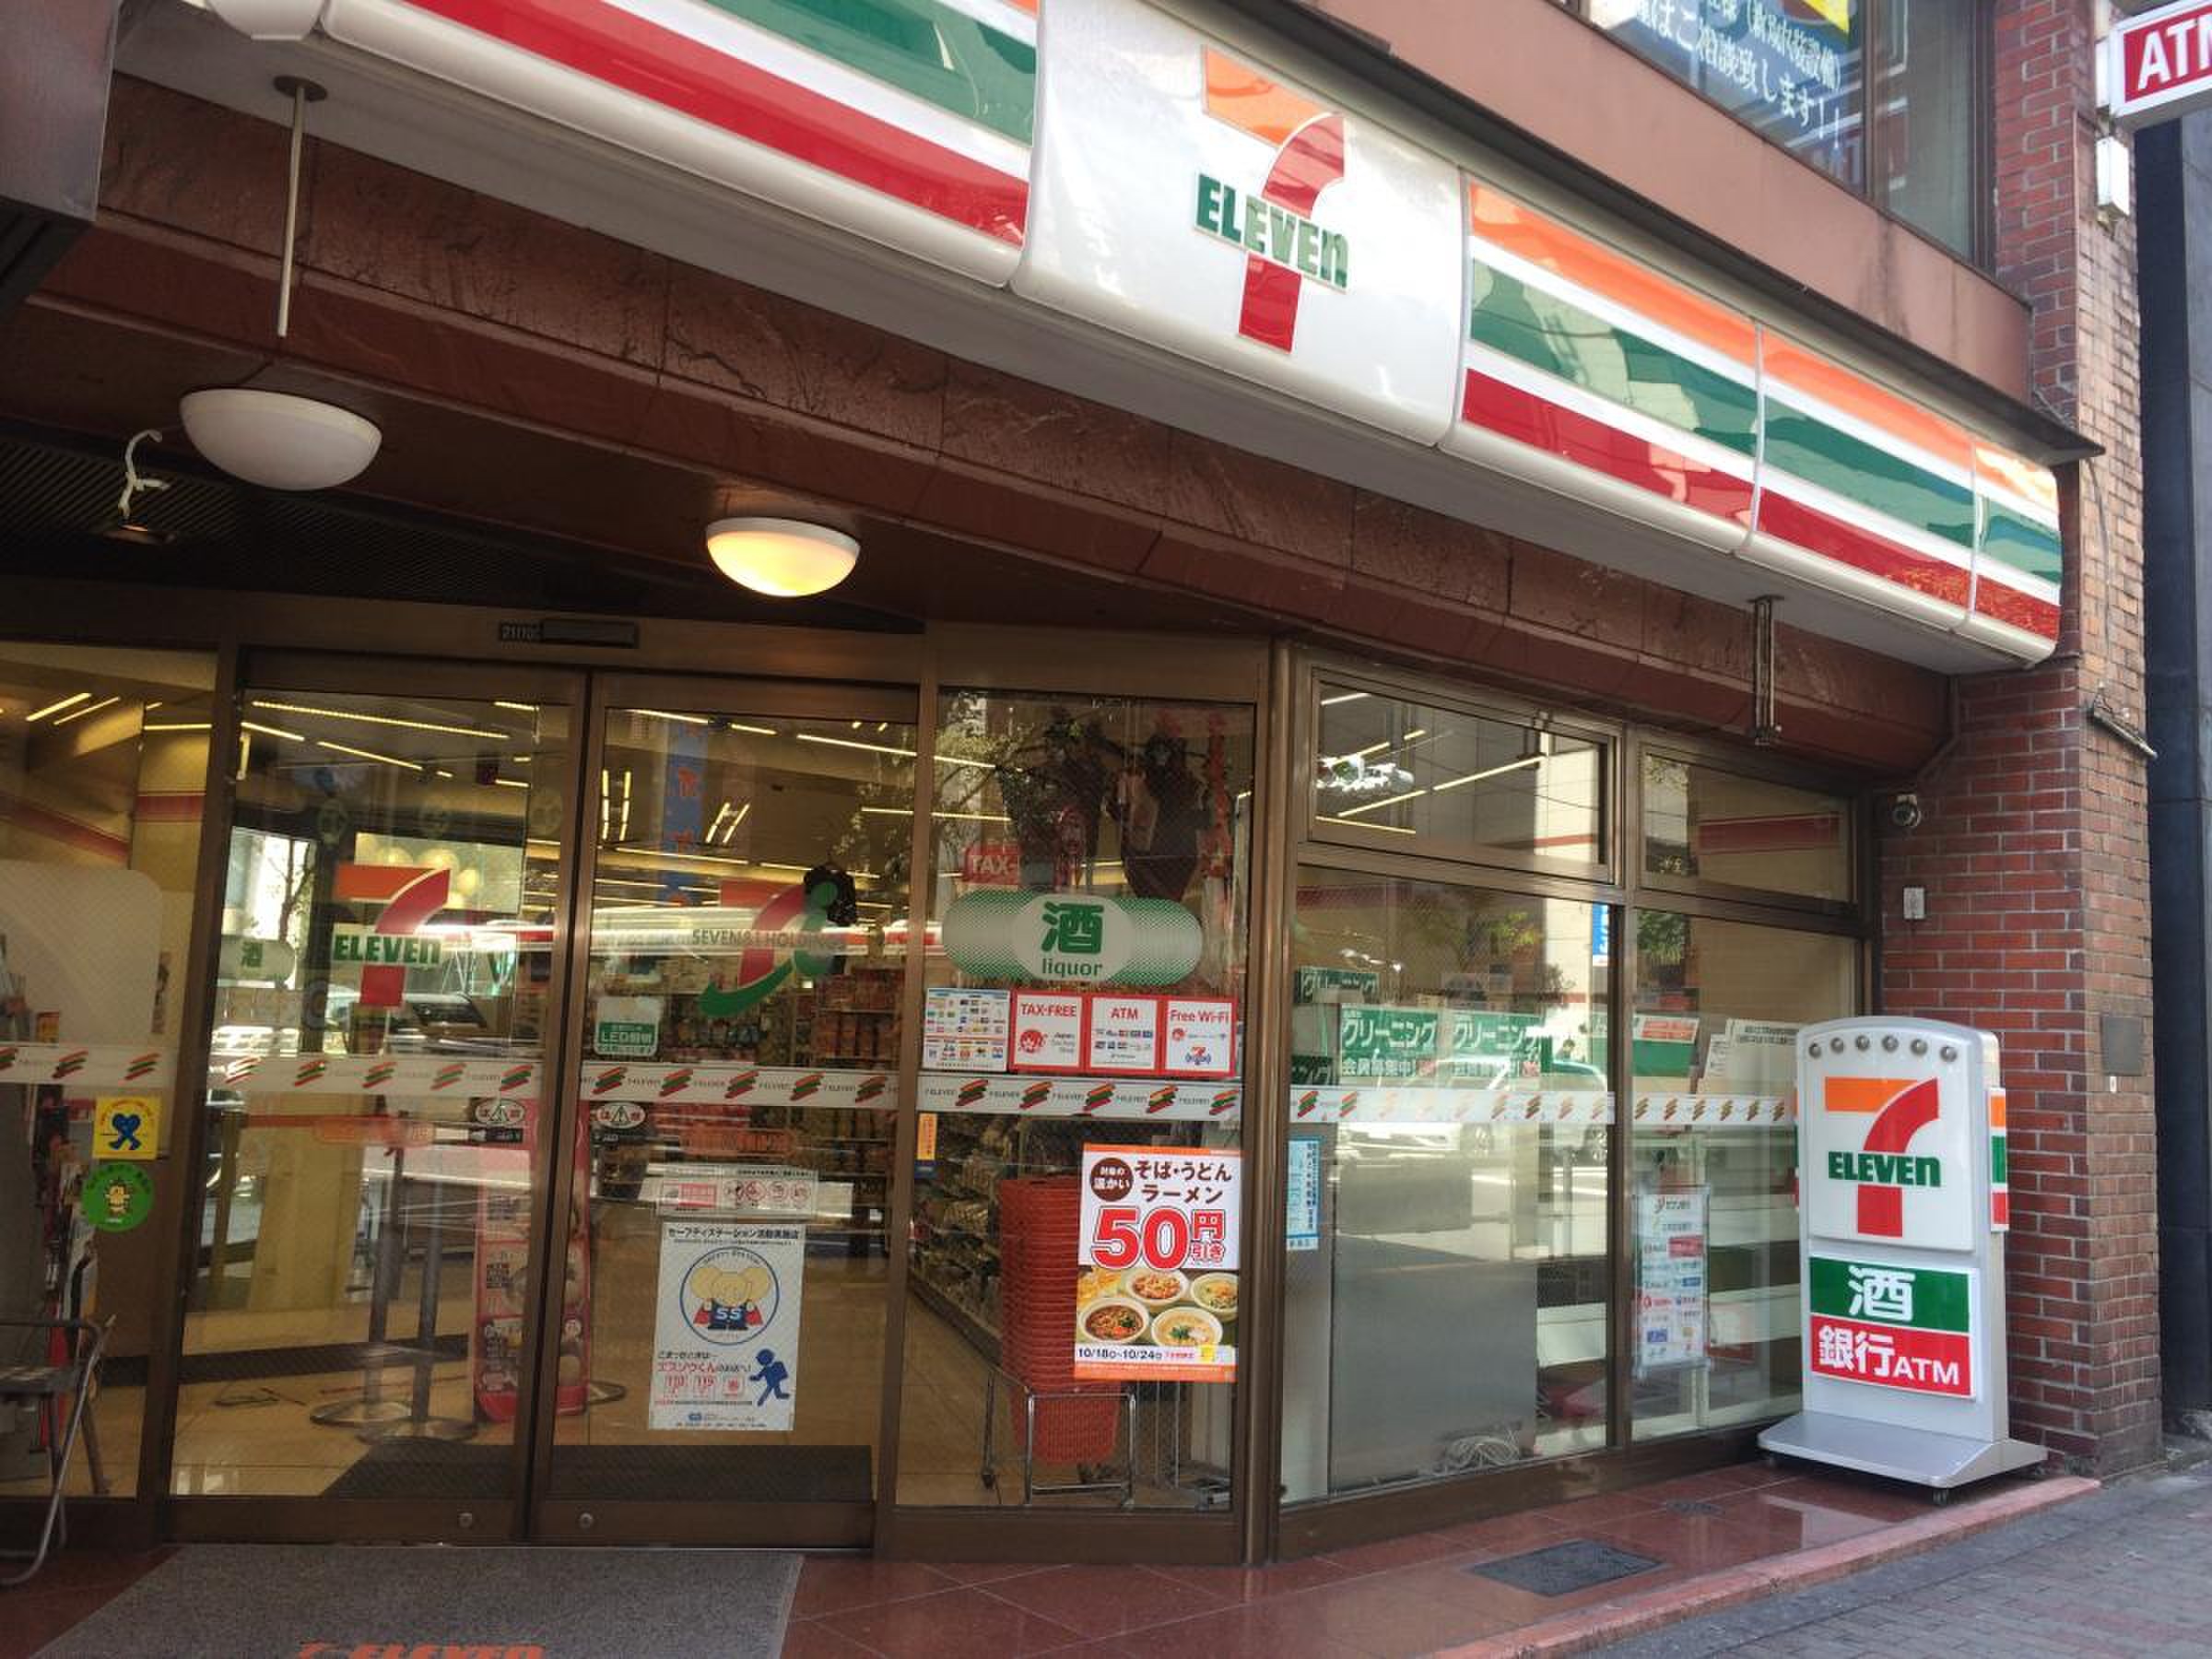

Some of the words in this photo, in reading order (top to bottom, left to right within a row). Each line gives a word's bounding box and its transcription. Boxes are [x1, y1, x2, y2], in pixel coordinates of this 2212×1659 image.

[1041, 900, 1103, 955] 酒
[1042, 959, 1102, 977] liquor
[1020, 1003, 1077, 1018] TAX-FREE
[1111, 1006, 1139, 1020] ATM
[1170, 1008, 1196, 1022] Free
[1199, 1010, 1230, 1025] Wi-Fi
[1342, 1018, 1438, 1049] クリーニング
[1135, 1160, 1232, 1182] そば・うどん
[1141, 1184, 1224, 1204] ラーメン
[1847, 1265, 1914, 1323] 酒
